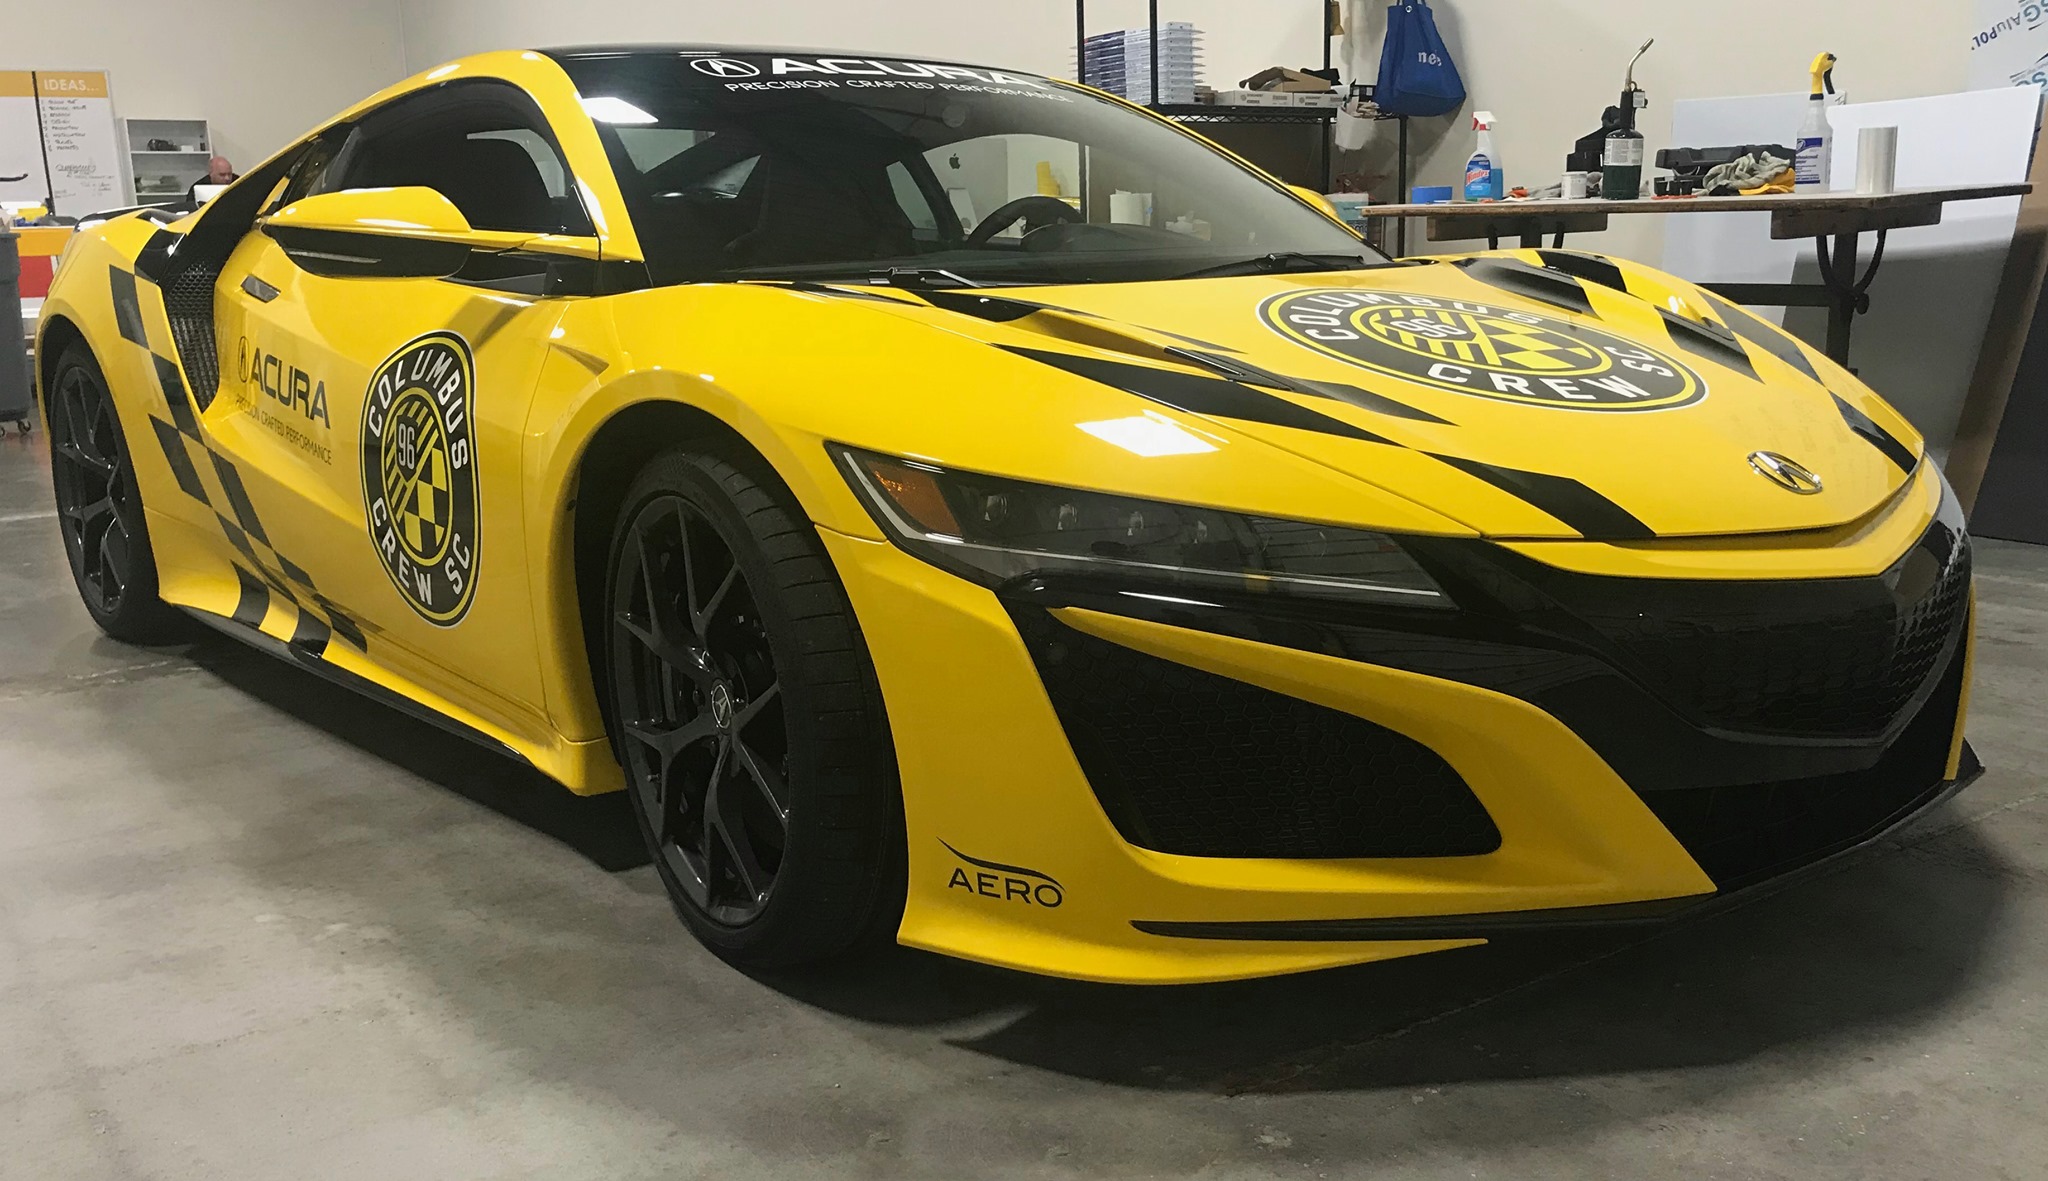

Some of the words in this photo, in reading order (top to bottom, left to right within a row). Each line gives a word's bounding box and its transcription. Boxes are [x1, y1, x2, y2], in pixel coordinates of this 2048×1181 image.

[724, 79, 841, 93] PRECISION
[845, 79, 935, 91] CRAFTED
[938, 83, 1075, 103] PERFORMANCE
[772, 57, 1049, 91] ACURA
[1290, 292, 1544, 342] COLUMBUS
[1386, 318, 1468, 340] 96
[250, 347, 331, 430] ACURA
[1427, 363, 1652, 401] CREW
[1603, 346, 1675, 378] SC
[368, 349, 468, 470] COLUMBUS
[261, 410, 285, 437] CRAFTED
[286, 425, 332, 466] PERFORMANCE
[397, 423, 415, 470] 96
[372, 497, 433, 606] CREW
[445, 532, 471, 595] SC
[948, 867, 1063, 908] AERO
